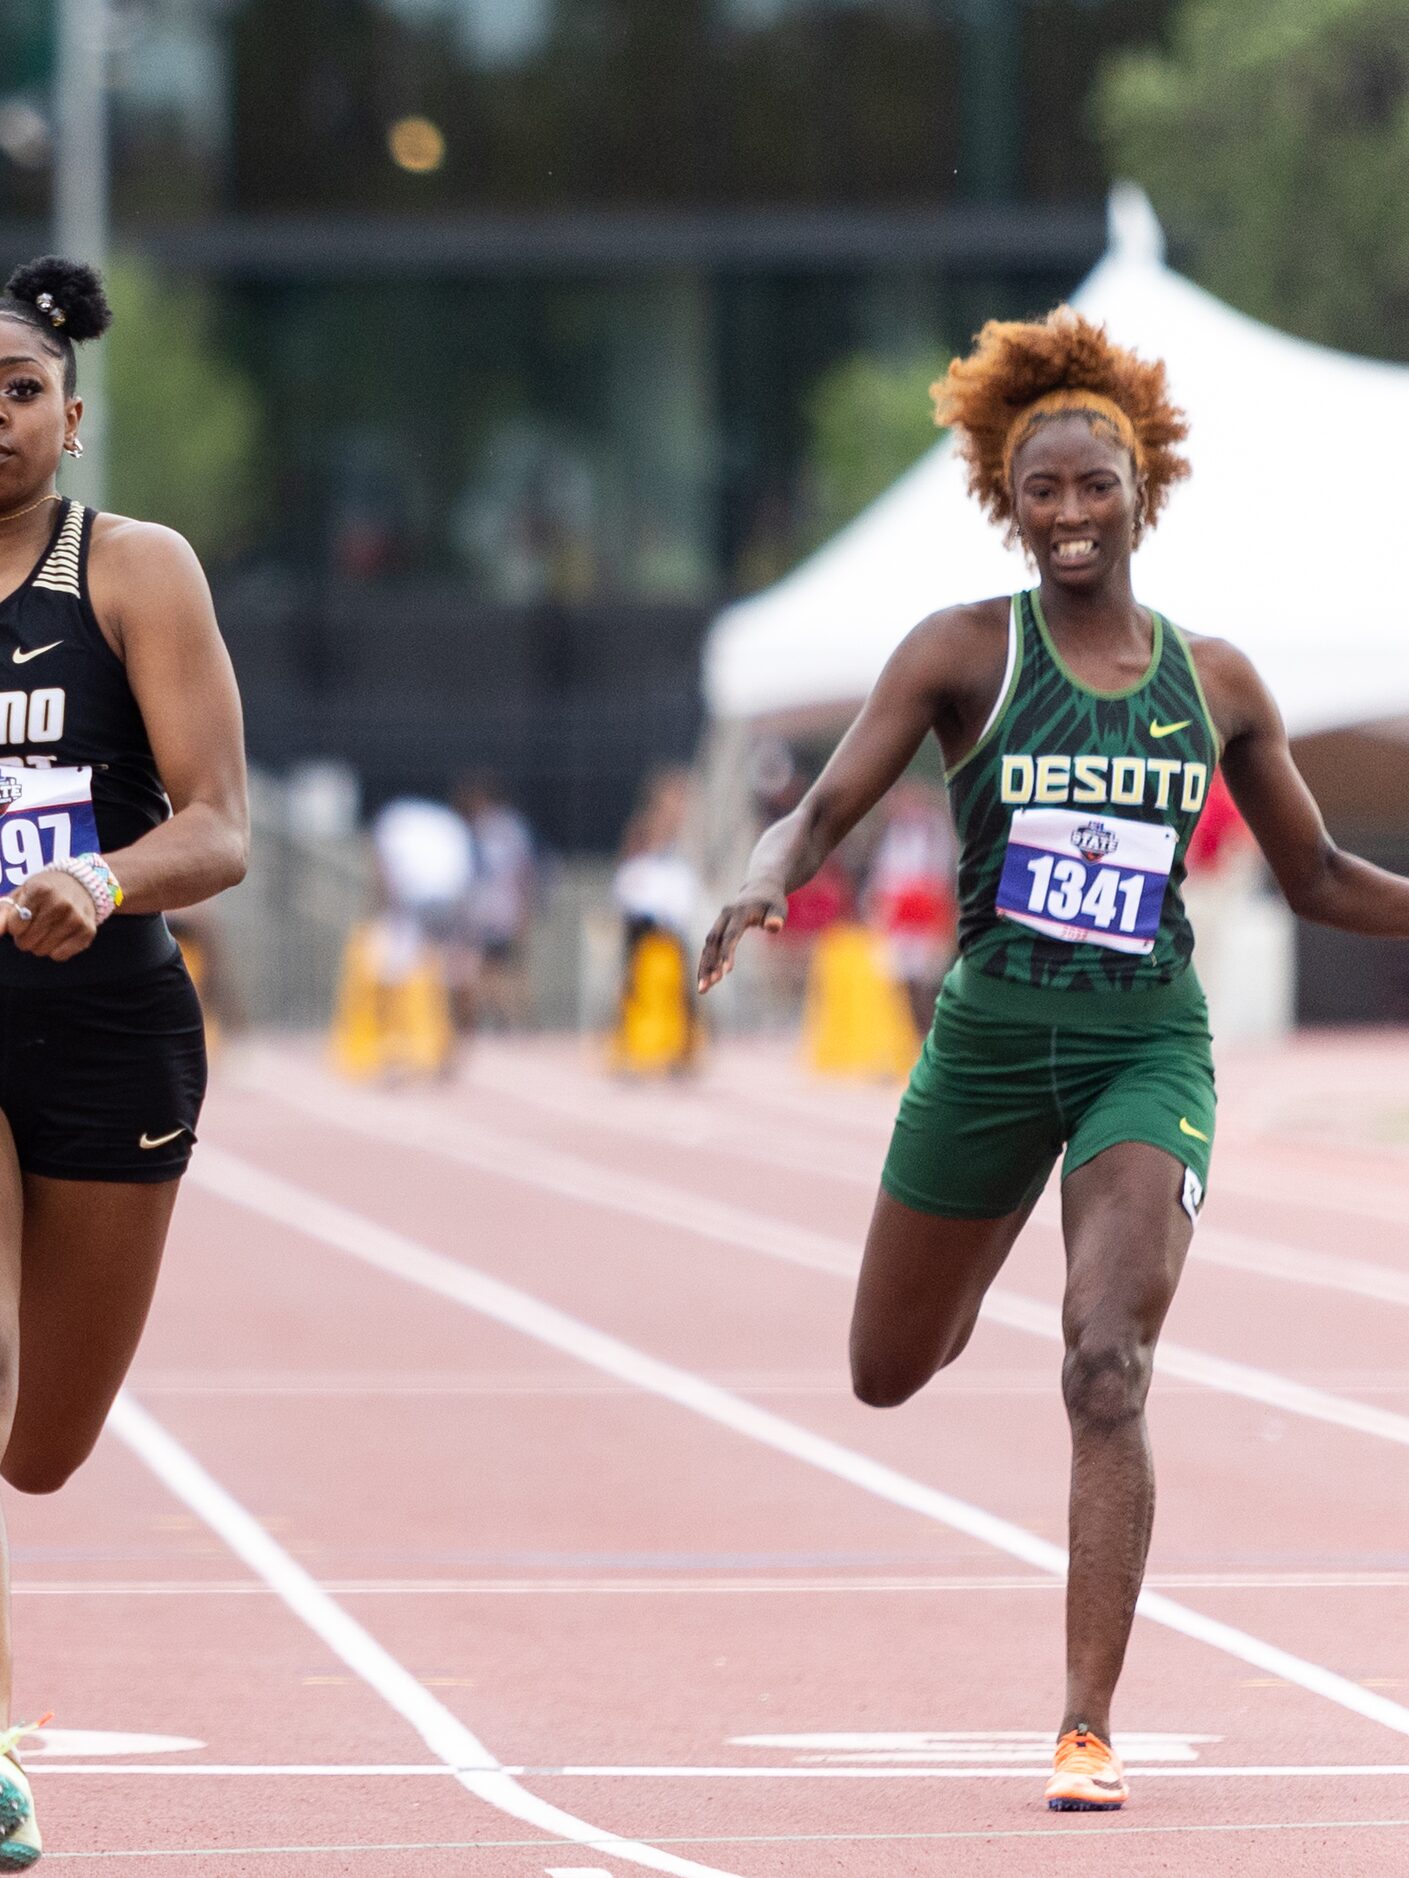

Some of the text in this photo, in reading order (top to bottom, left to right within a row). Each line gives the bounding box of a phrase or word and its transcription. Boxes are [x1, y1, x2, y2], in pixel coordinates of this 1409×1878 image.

[1000, 754, 1208, 813] DESOTO
[1070, 830, 1119, 853] STATE
[1027, 855, 1145, 933] 1341
